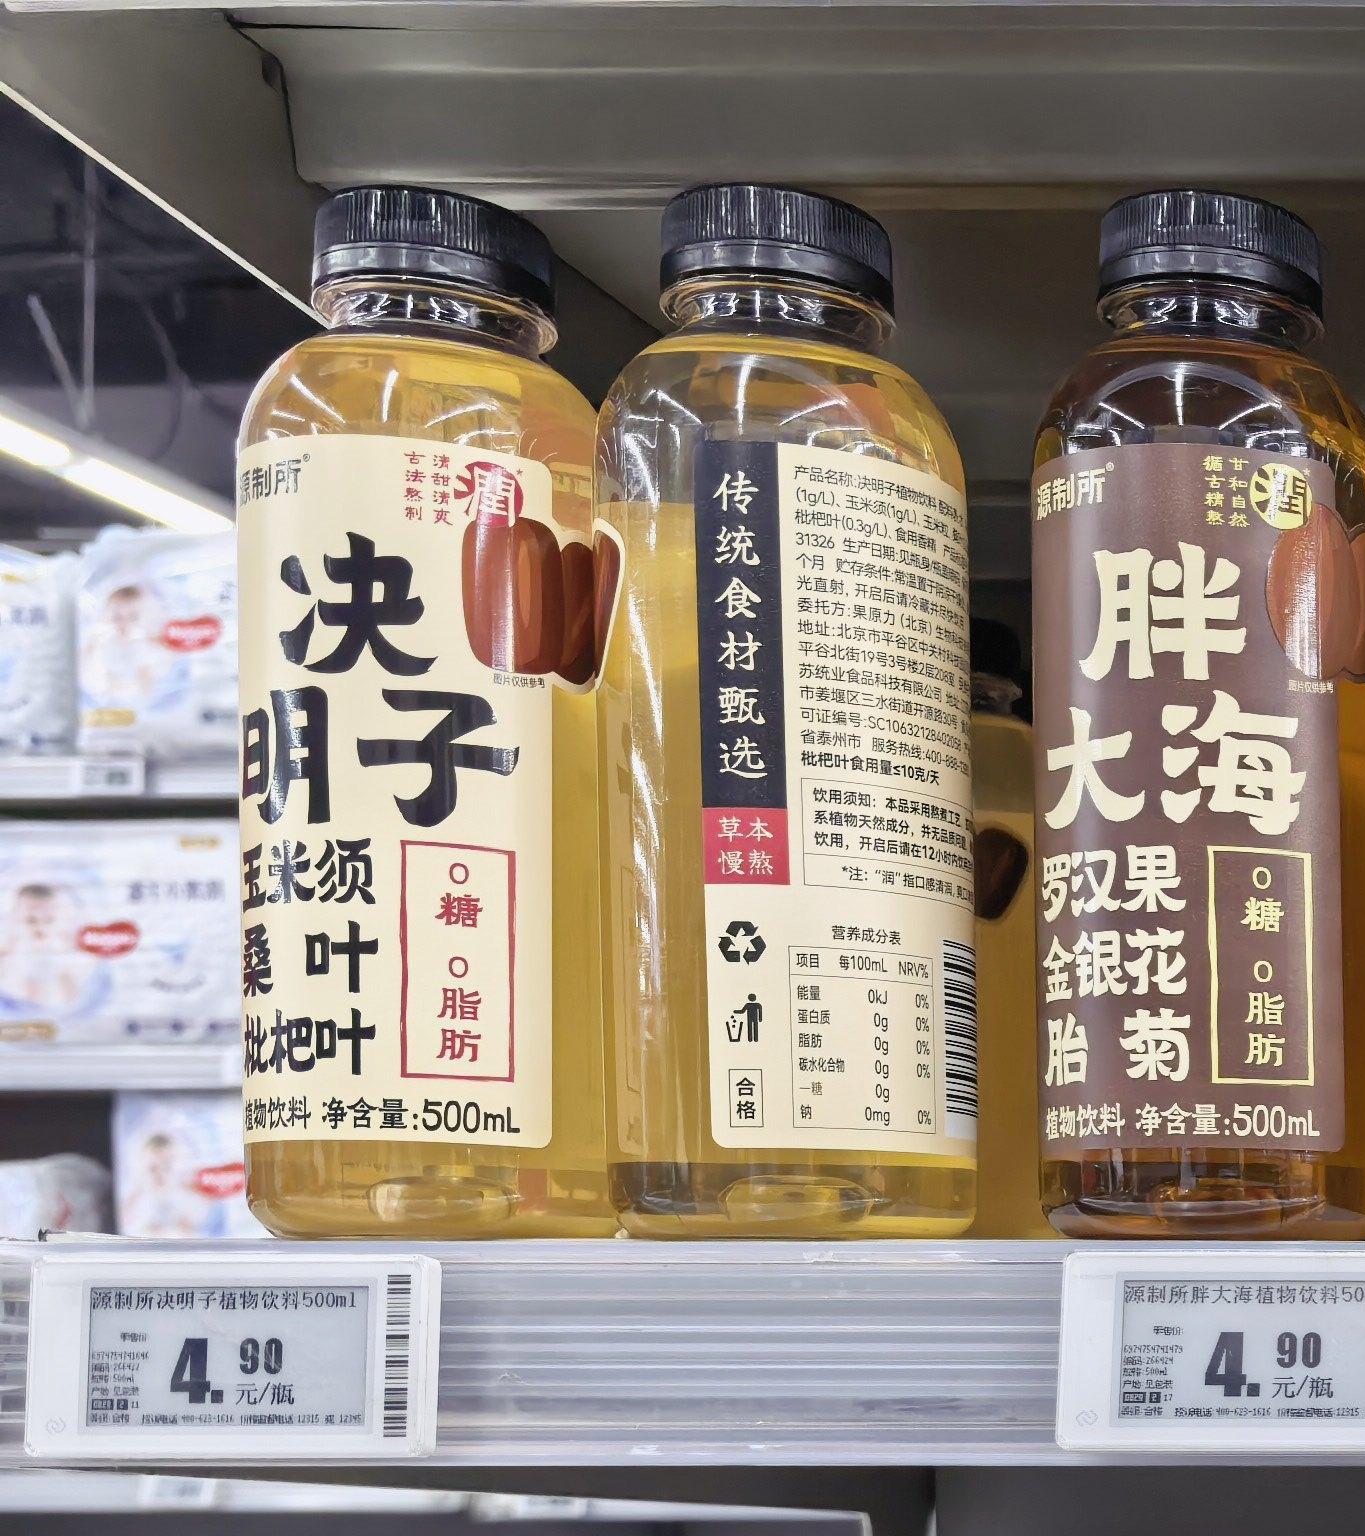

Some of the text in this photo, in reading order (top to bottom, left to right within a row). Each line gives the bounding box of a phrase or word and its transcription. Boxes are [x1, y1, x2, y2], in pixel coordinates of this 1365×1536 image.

[279, 532, 438, 676] 决
[713, 471, 768, 779] 传统食材甄选
[1080, 541, 1246, 680] 胖
[242, 686, 519, 827] 明子
[1045, 691, 1306, 835] 大海
[718, 816, 774, 842] 草本
[718, 849, 773, 876] 慢熬
[242, 838, 373, 906] 玉米须
[1042, 844, 1185, 922] 罗汉果
[796, 953, 929, 979] 项目 每100mL NRV%
[832, 926, 901, 946] 营养成分表
[1042, 929, 1186, 1001] 金银花
[244, 1008, 375, 1076] 枇杷叶
[245, 1098, 520, 1134] 植物饮料 净含量:500mL
[736, 1078, 756, 1119] 合格
